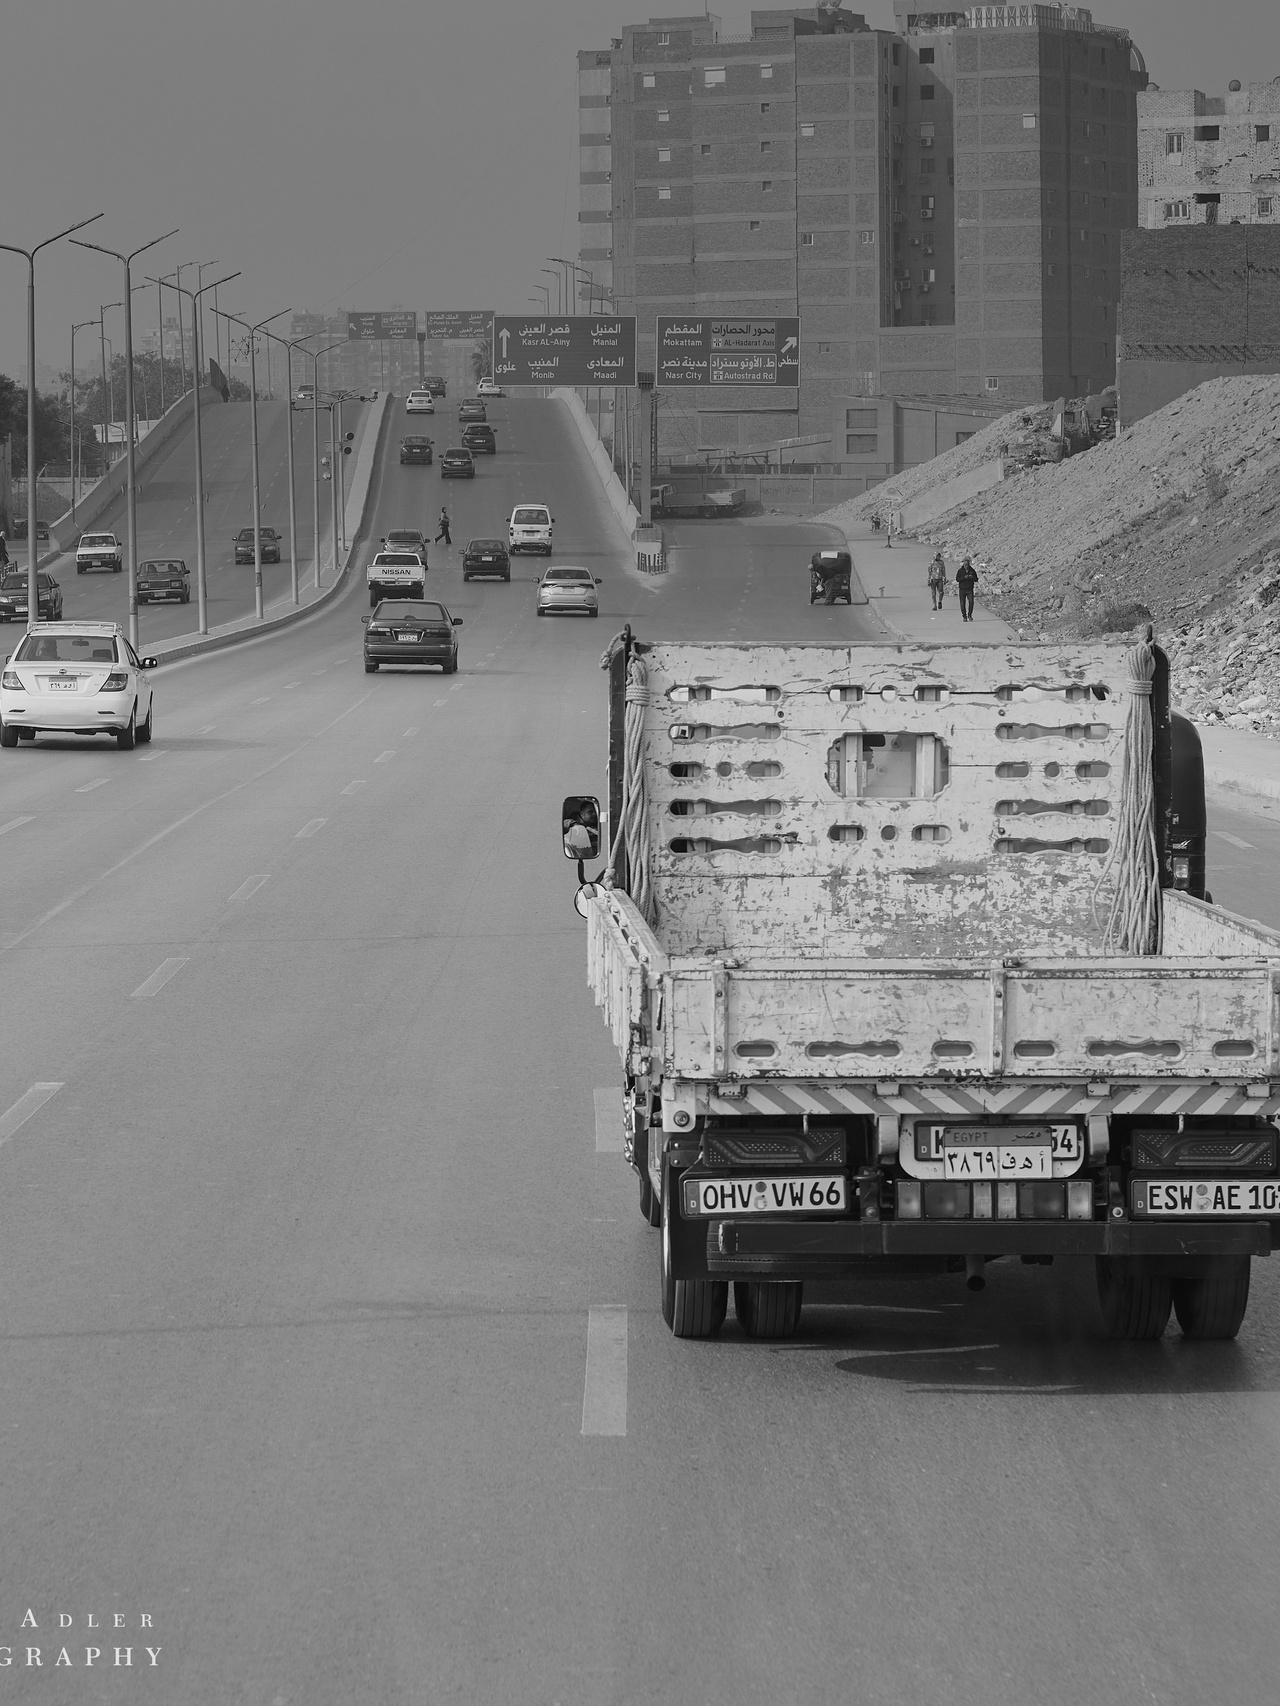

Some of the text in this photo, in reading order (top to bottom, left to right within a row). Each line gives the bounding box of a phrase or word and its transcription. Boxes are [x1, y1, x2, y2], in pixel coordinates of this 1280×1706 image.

[548, 324, 570, 336] قصر
[590, 323, 621, 336] المنيل
[665, 323, 702, 337] المقطم
[712, 324, 775, 336] محور الحضارات
[528, 356, 559, 369] المنيب
[660, 356, 708, 370] مدينة نصر
[686, 372, 702, 380] City
[724, 372, 775, 380] Autostrad Rd.
[953, 1132, 989, 1142] EGYPT
[1011, 1131, 1042, 1142] مصر
[947, 1151, 996, 1174] ٣٨٦٩
[703, 1183, 752, 1210] OHV
[1149, 1185, 1193, 1210] ESW
[1212, 1185, 1241, 1210] AE
[1248, 1185, 1280, 1210] 10
